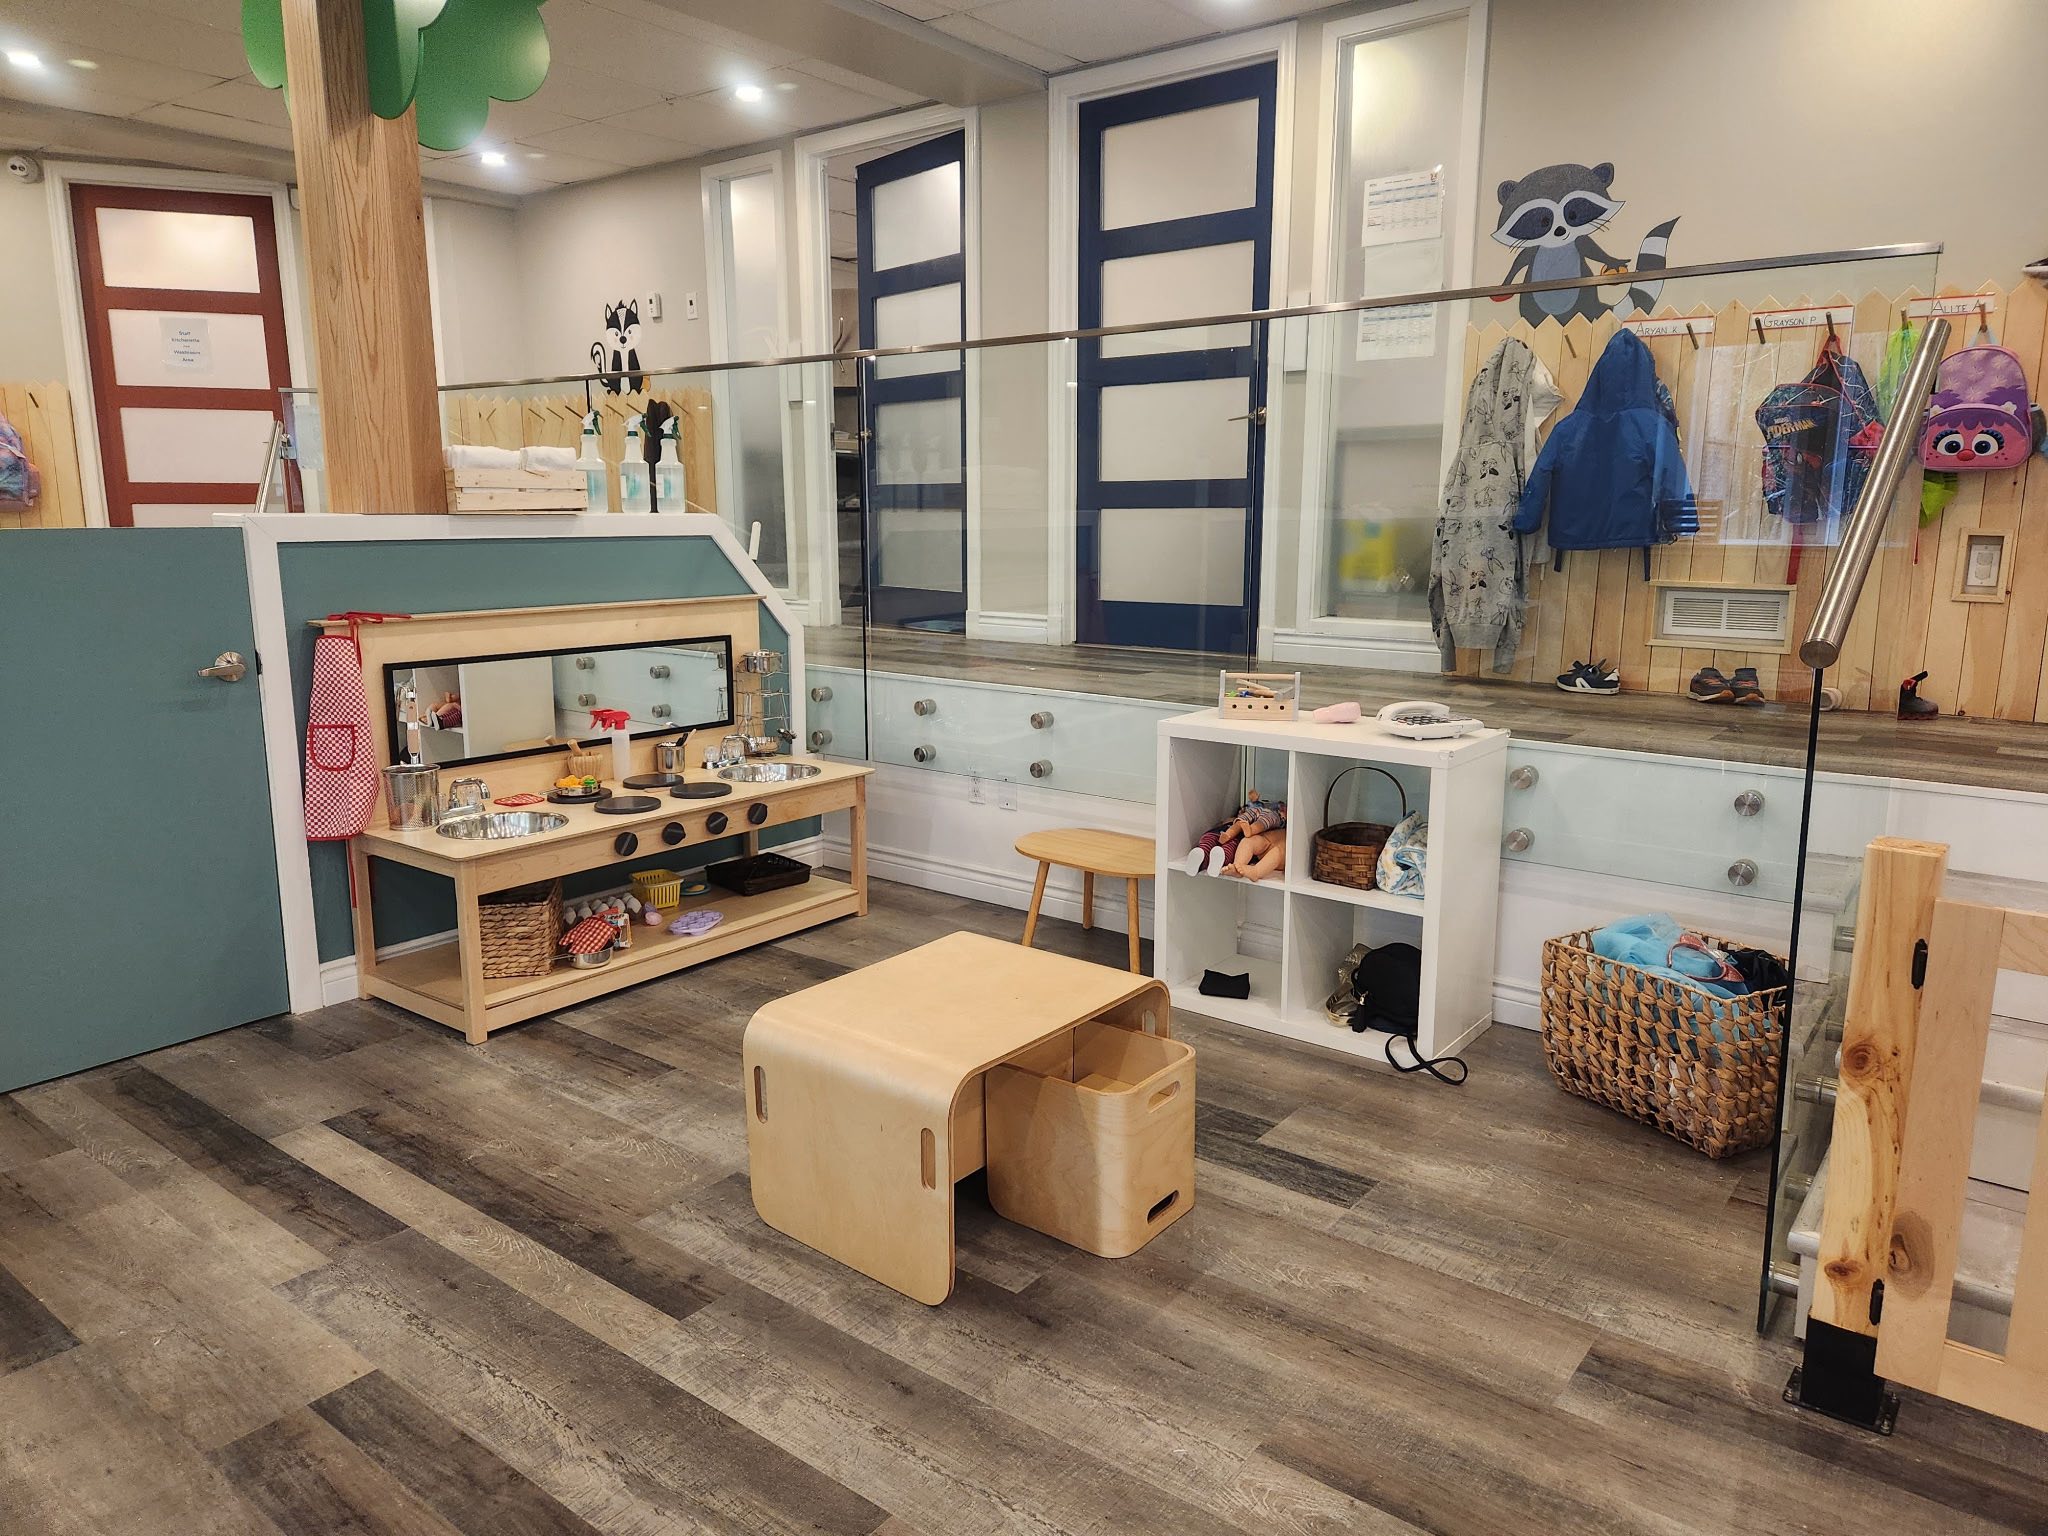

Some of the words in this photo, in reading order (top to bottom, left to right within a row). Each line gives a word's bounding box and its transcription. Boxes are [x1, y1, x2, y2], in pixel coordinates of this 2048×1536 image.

[1764, 314, 1805, 328] GRAYSON
[1634, 322, 1668, 336] ARYAN
[1672, 326, 1678, 334] K
